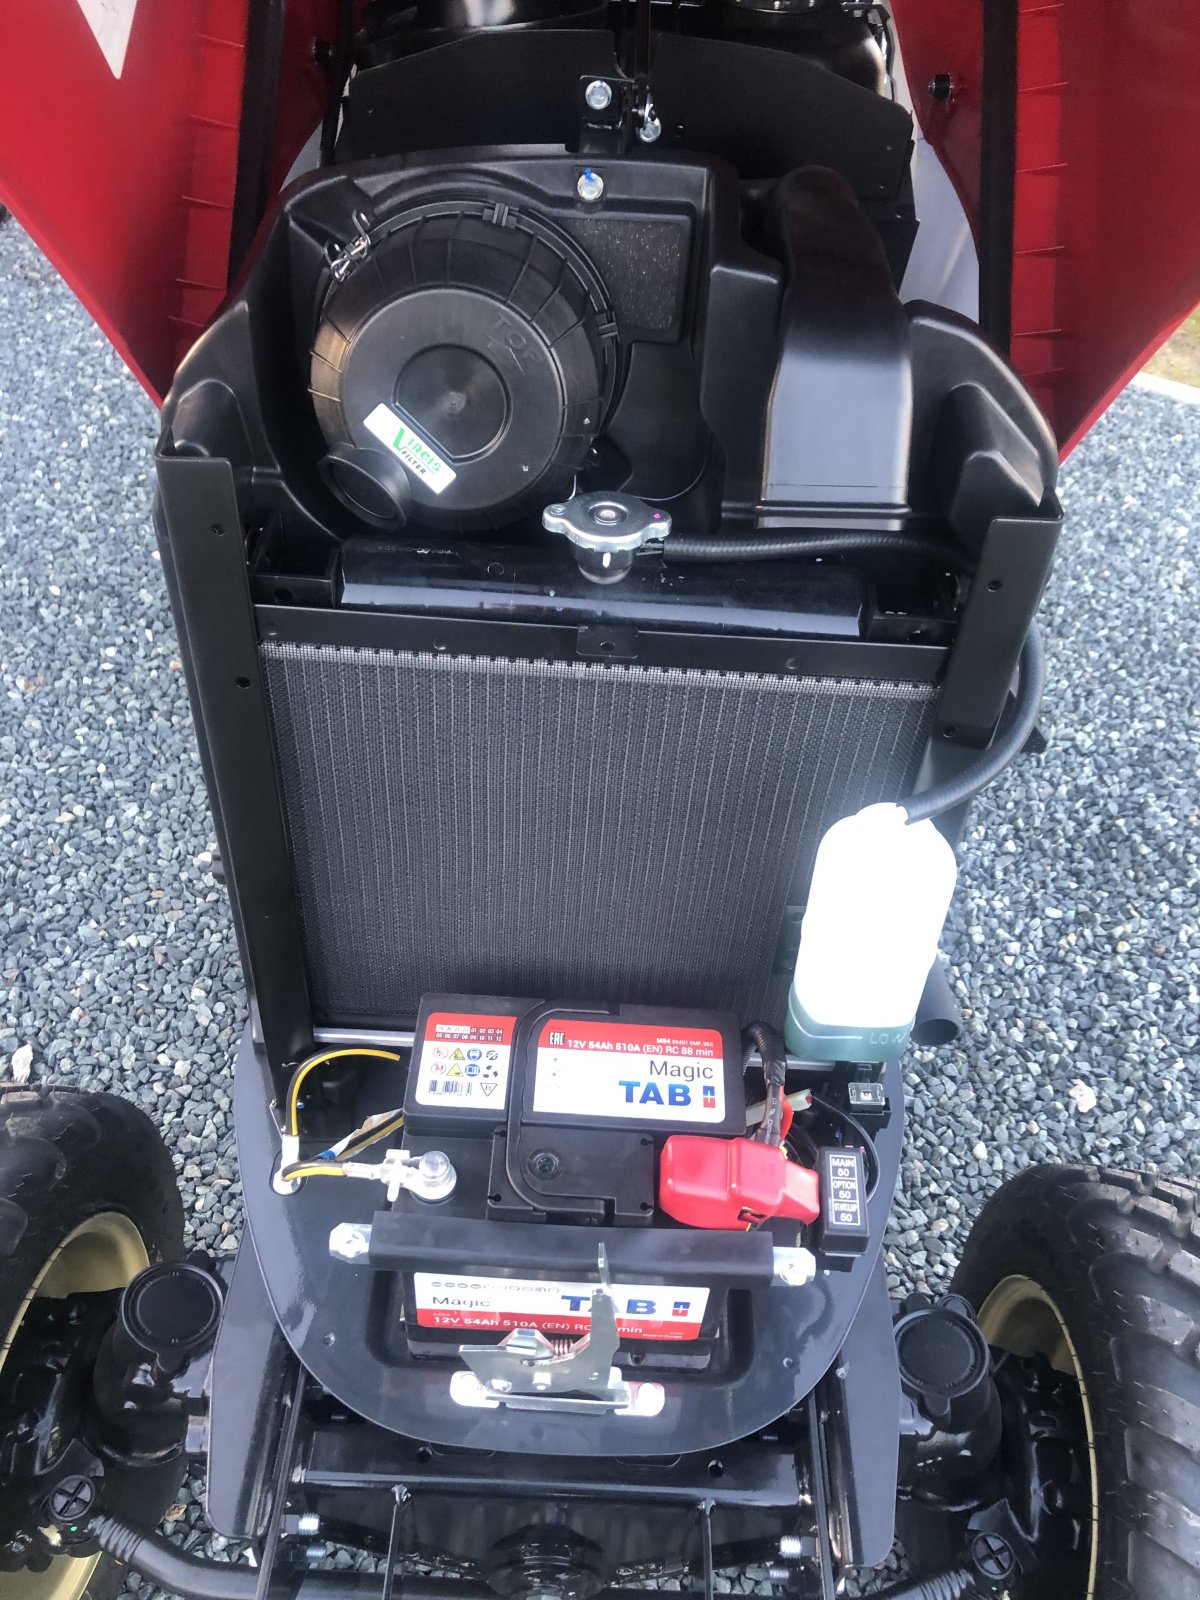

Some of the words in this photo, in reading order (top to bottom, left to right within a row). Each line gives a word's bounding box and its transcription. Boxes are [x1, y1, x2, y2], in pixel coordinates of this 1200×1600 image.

[401, 450, 427, 475] FILTER
[549, 1031, 565, 1046] EAC
[870, 1032, 907, 1045] LOW
[567, 1039, 587, 1049] 12V
[588, 1040, 614, 1051] 54Ah
[615, 1042, 641, 1053] 510A
[642, 1043, 663, 1055] (EN)
[665, 1046, 679, 1055] RC
[681, 1046, 693, 1055] 88
[695, 1047, 714, 1057] min
[649, 1060, 714, 1082] Magic
[618, 1080, 692, 1107] TAB
[831, 1157, 855, 1168] MAIN
[837, 1168, 850, 1177] 50
[832, 1180, 857, 1190] OPTION
[838, 1190, 852, 1199] 50
[840, 1213, 853, 1222] 50
[432, 1296, 491, 1308] Magic
[433, 1316, 460, 1324] 12V
[463, 1317, 499, 1326] 54Ah
[503, 1319, 538, 1328] 510A
[542, 1321, 570, 1331] (EN)
